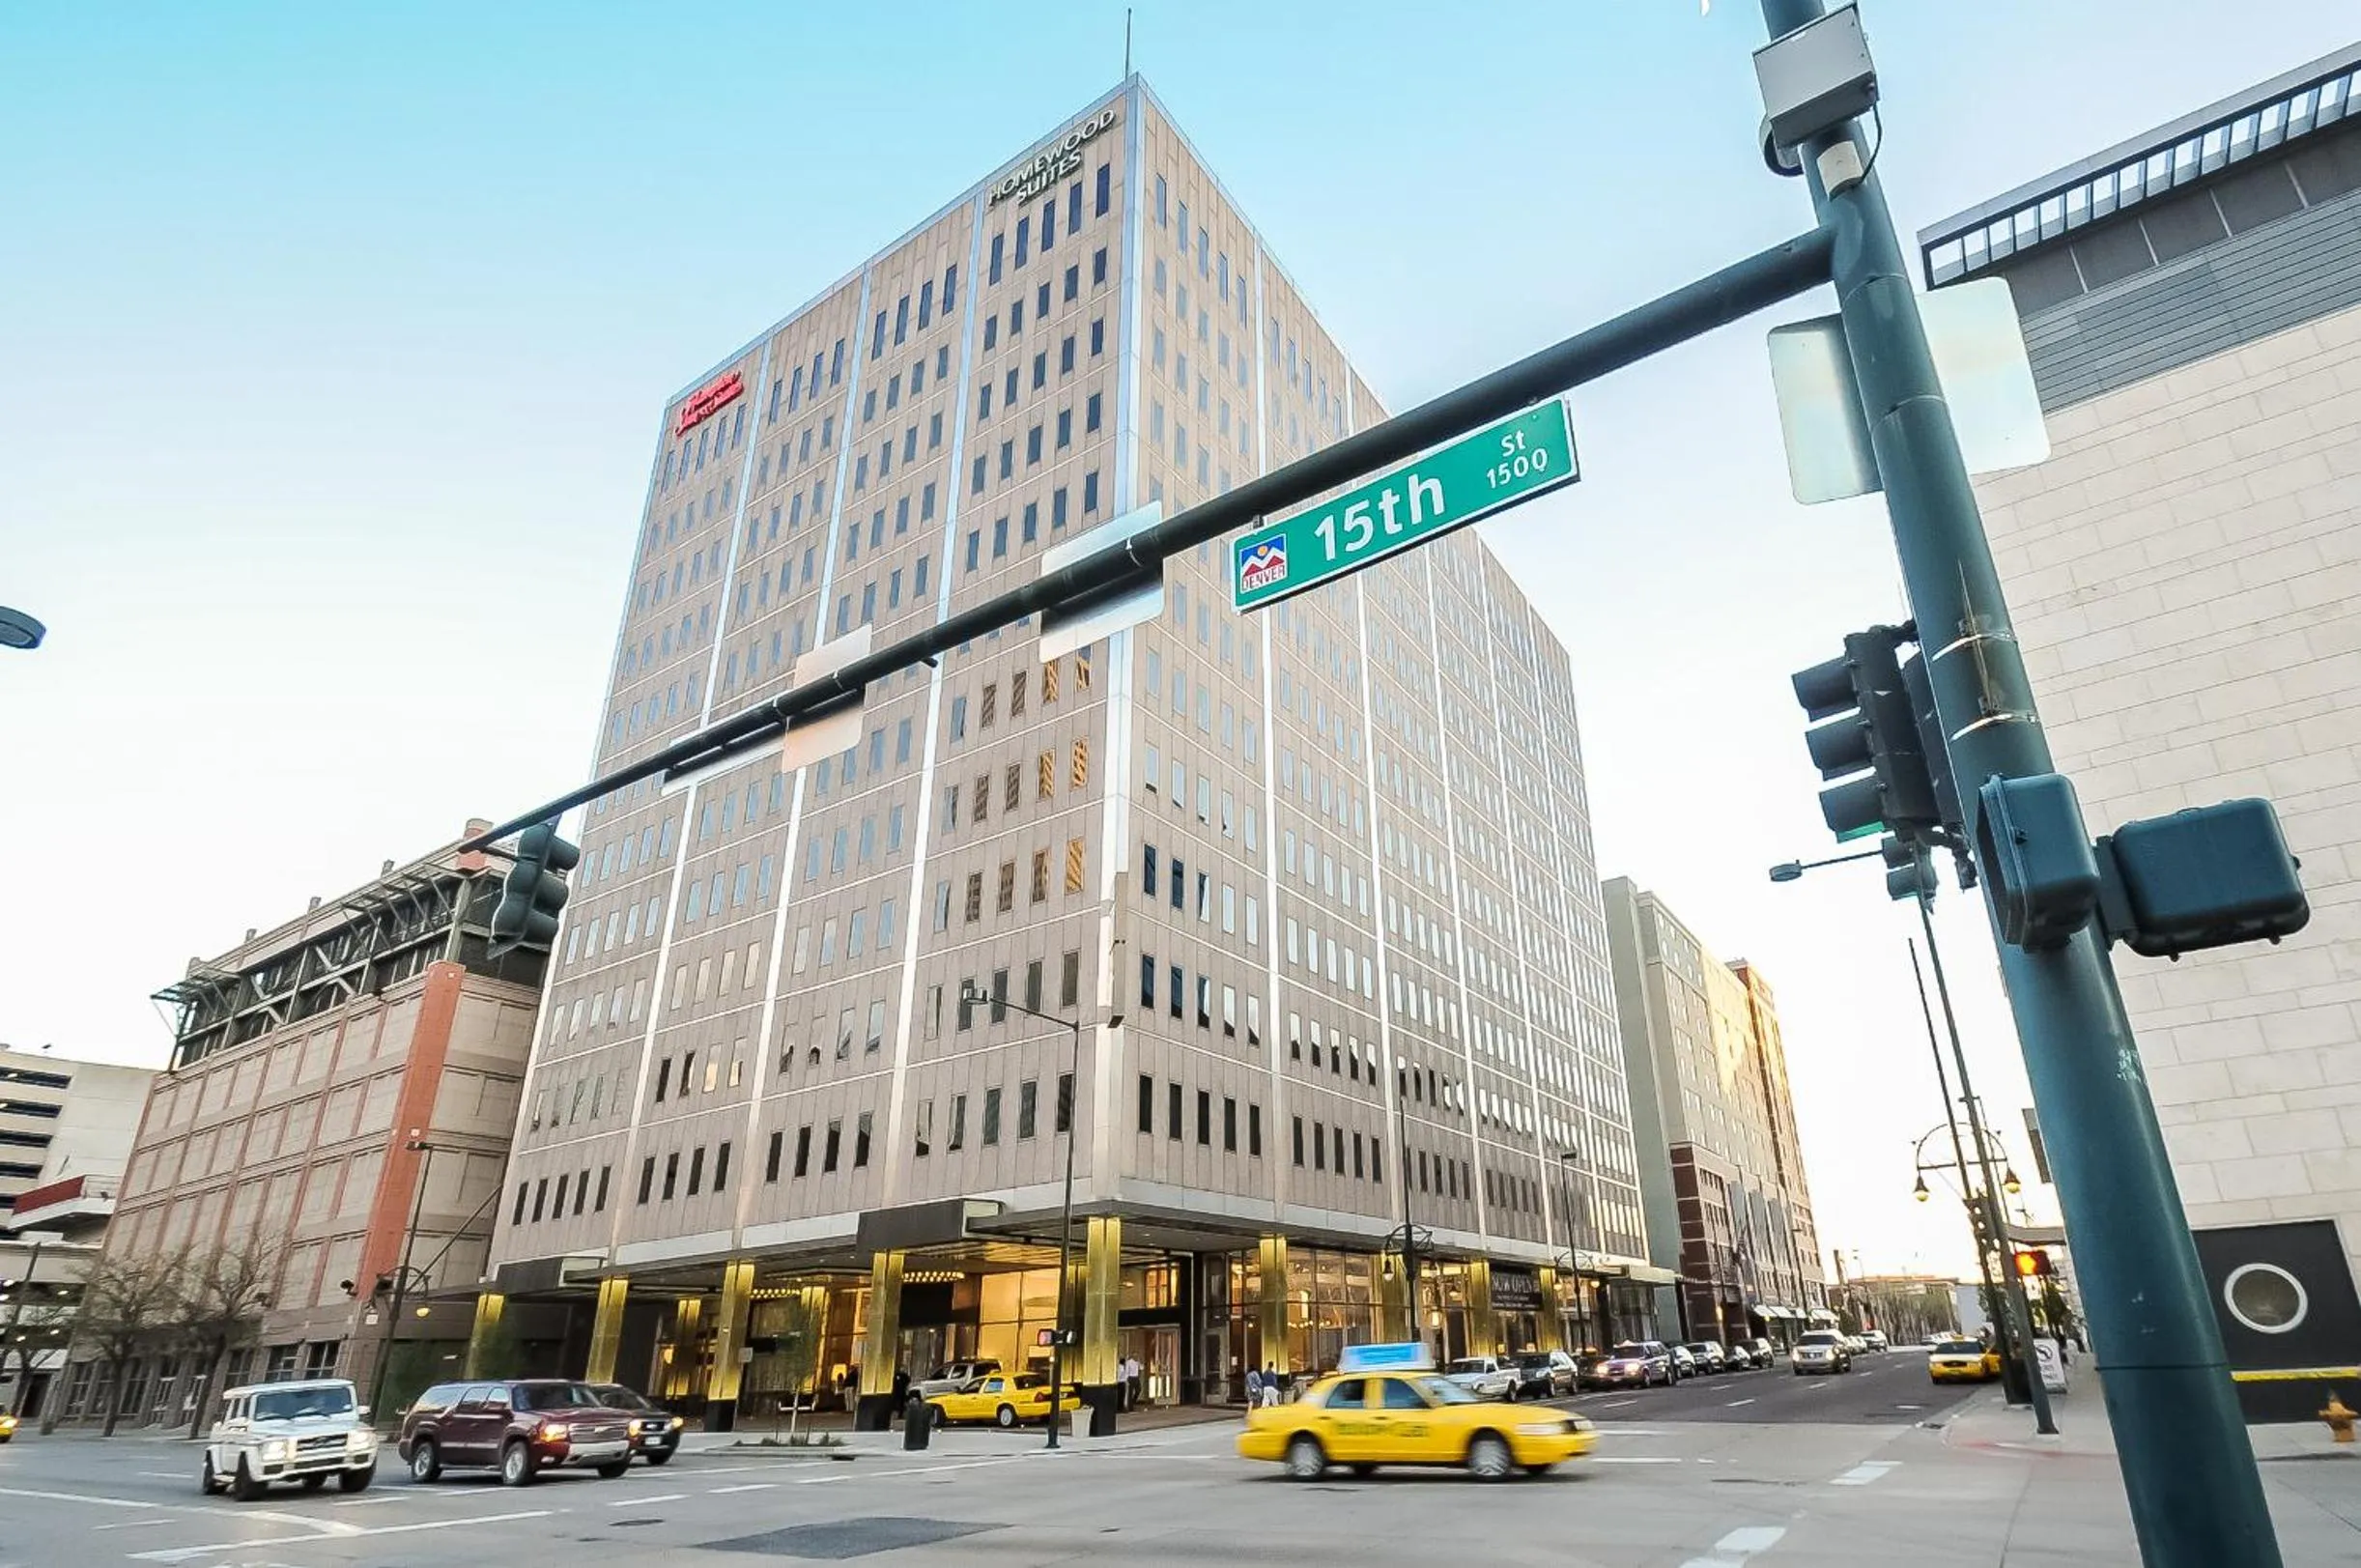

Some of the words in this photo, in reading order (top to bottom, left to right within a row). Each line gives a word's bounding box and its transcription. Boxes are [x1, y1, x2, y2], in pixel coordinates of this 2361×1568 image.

[988, 109, 1115, 206] HOMEWOOD
[1017, 149, 1082, 207] SUITES
[1501, 430, 1525, 457] St
[1487, 448, 1548, 489] 1500
[1314, 473, 1445, 561] 15th
[1241, 564, 1286, 590] DENVER
